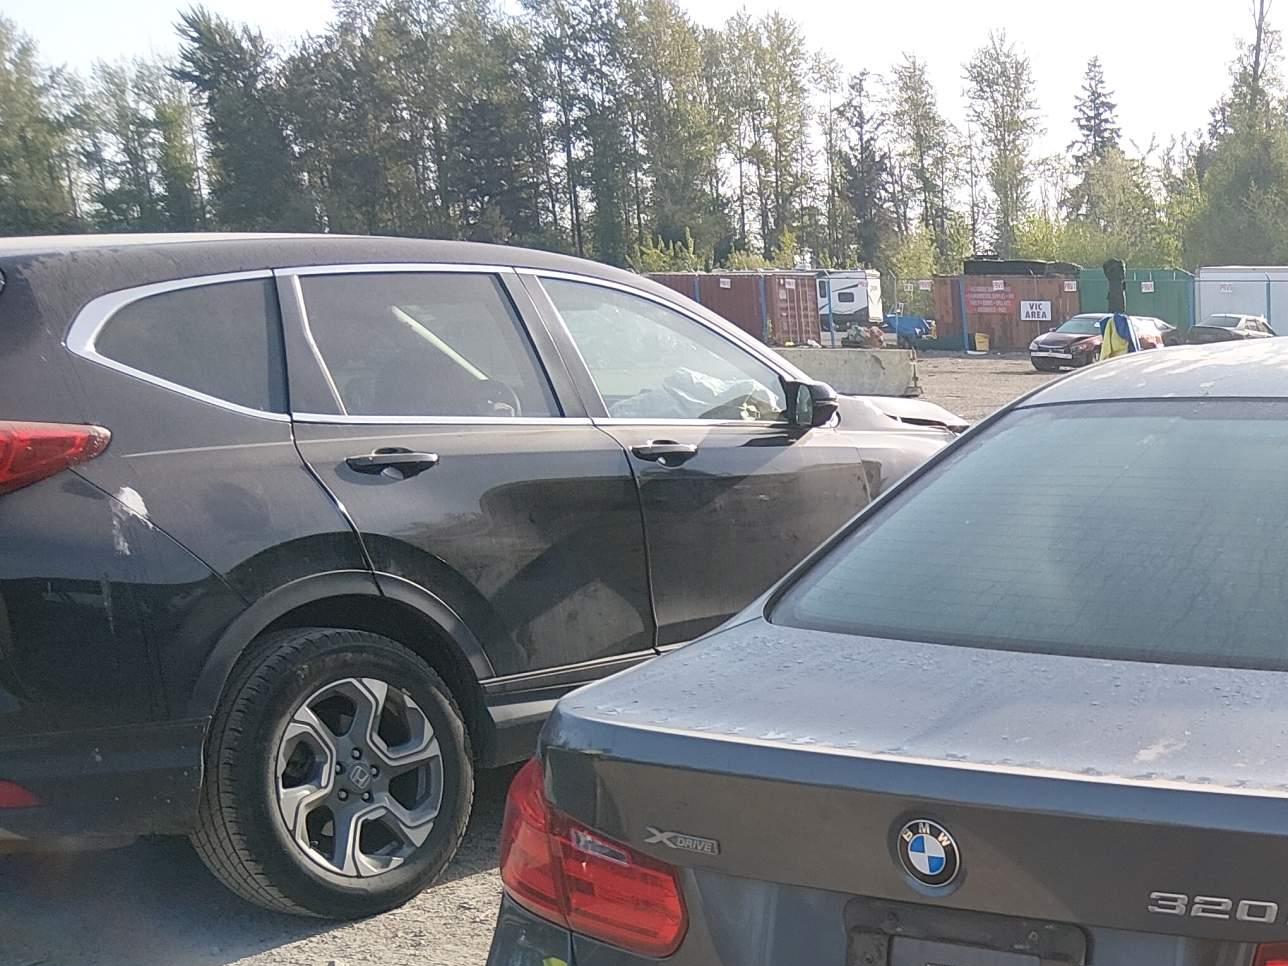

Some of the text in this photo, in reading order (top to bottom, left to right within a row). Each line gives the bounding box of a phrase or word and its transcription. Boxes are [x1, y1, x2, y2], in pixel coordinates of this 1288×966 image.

[1029, 303, 1043, 311] VIC
[1025, 311, 1047, 319] AREA
[902, 822, 951, 847] BMW
